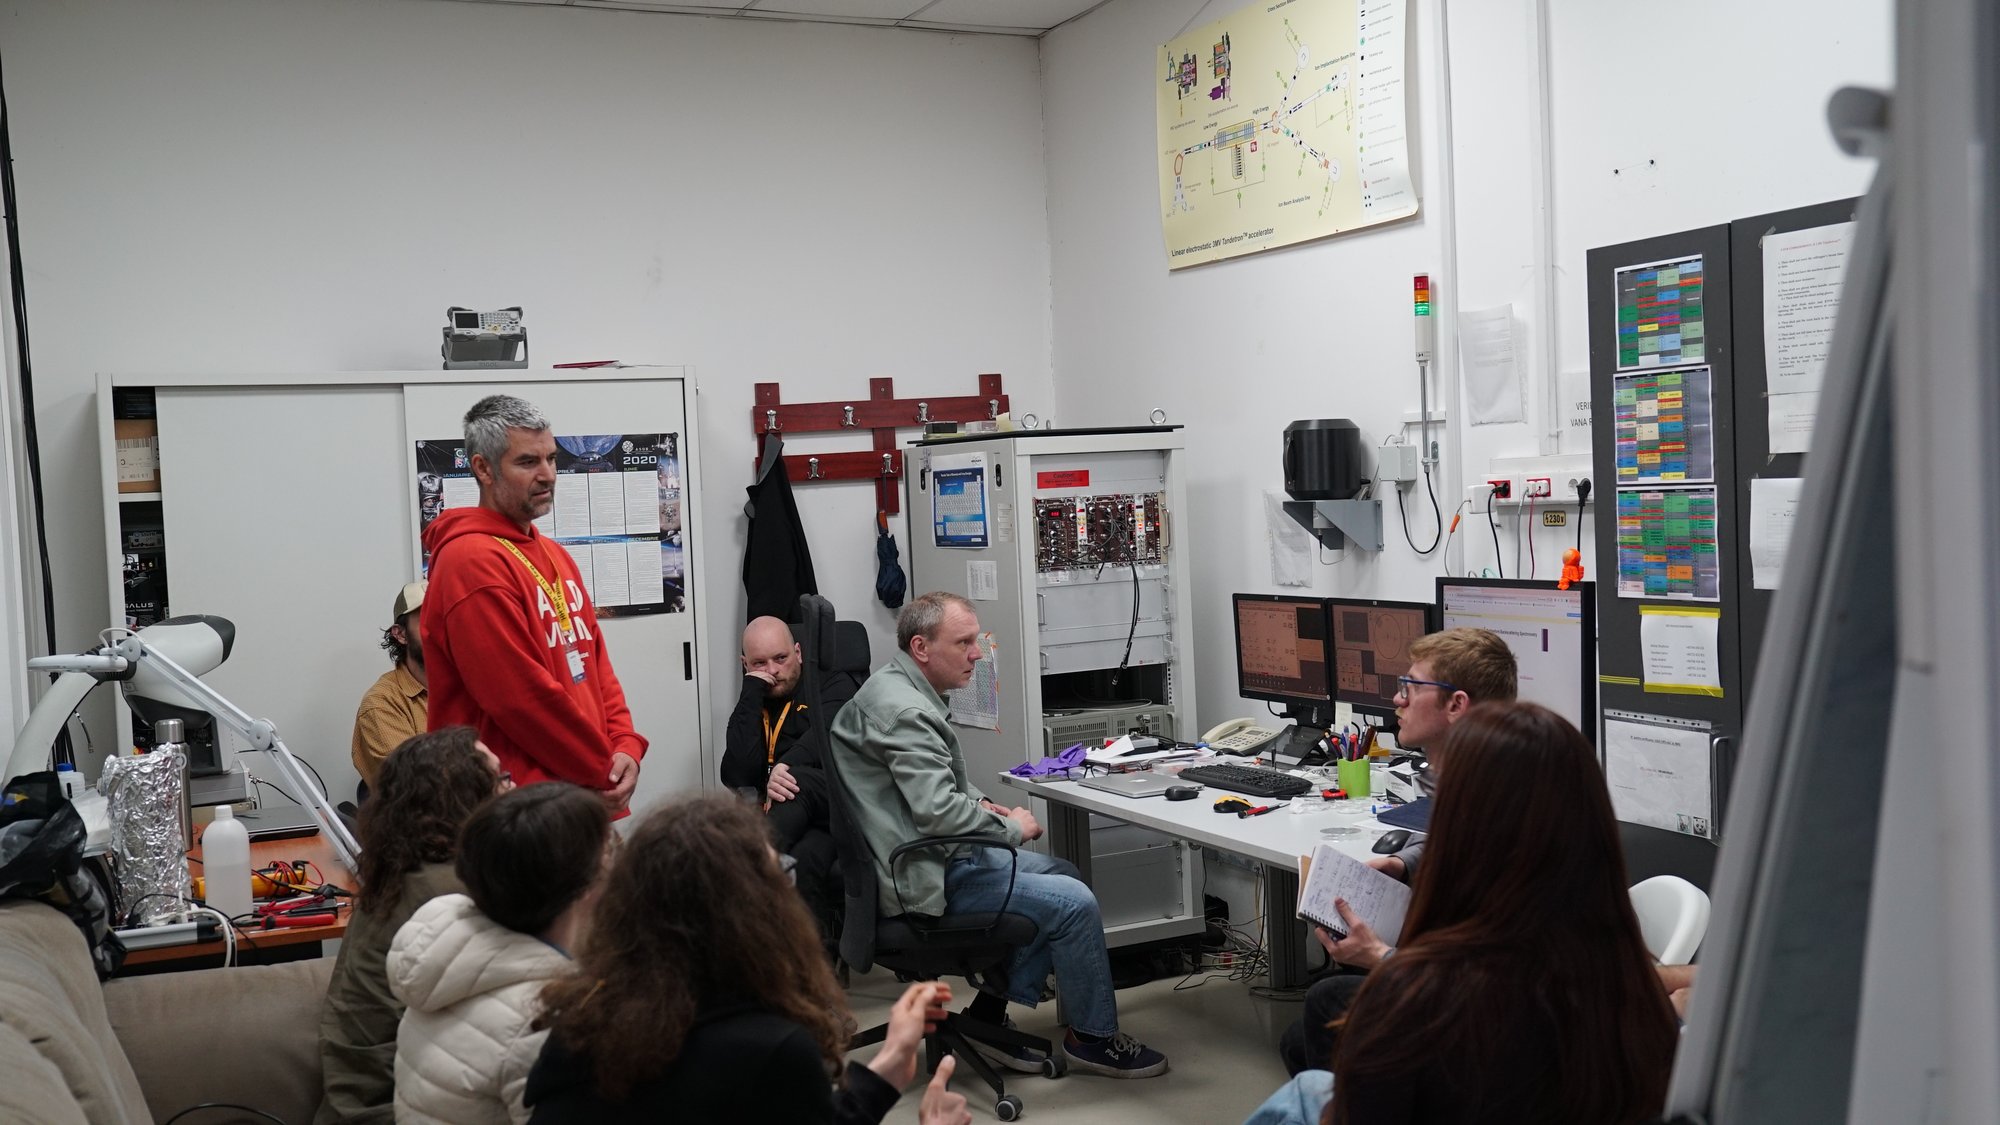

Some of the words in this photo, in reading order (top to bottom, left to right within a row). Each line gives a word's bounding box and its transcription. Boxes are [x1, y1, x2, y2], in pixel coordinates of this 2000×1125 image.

[1171, 248, 1186, 257] Linear
[1186, 242, 1212, 254] electrostatic
[1247, 227, 1275, 239] accelerator
[1570, 418, 1588, 427] VANA
[623, 456, 657, 465] 2020
[1105, 1048, 1119, 1060] FILA
